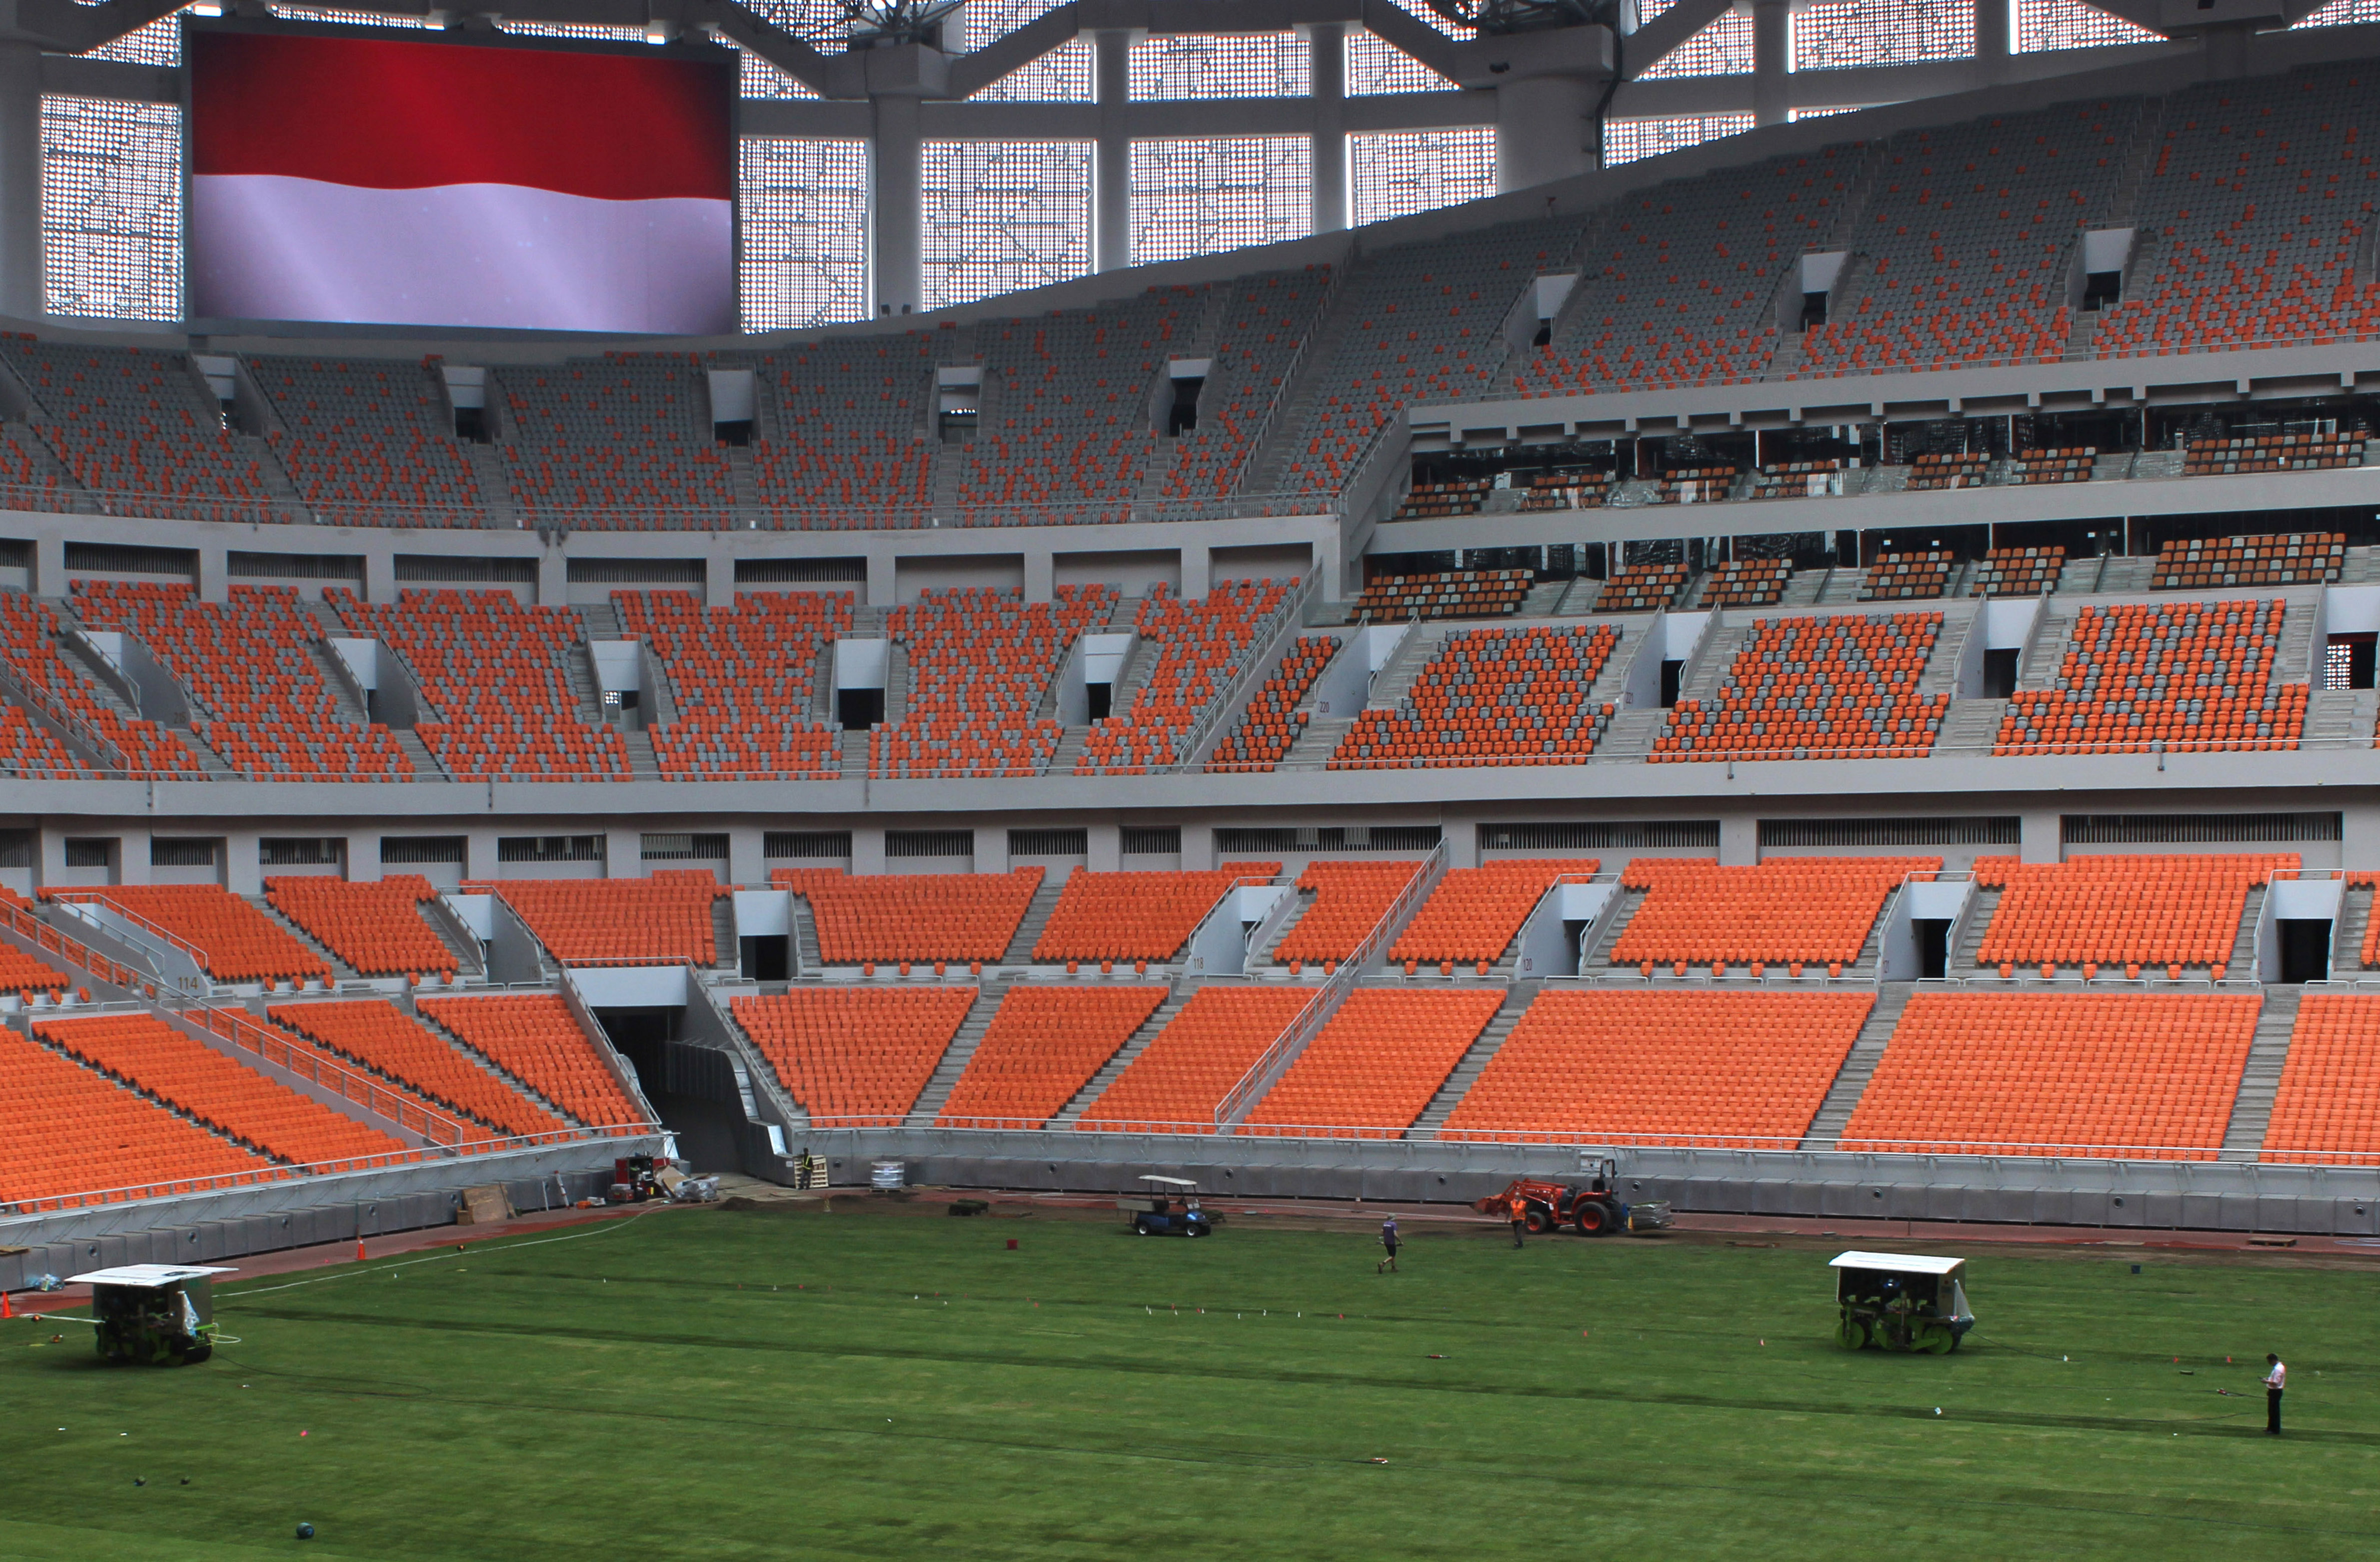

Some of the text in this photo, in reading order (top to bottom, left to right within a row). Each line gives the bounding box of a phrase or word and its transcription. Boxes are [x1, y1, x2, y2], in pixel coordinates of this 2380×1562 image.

[1320, 701, 1329, 713] 220
[1194, 957, 1204, 969] 118
[1523, 958, 1532, 971] 120
[177, 976, 198, 990] 114
